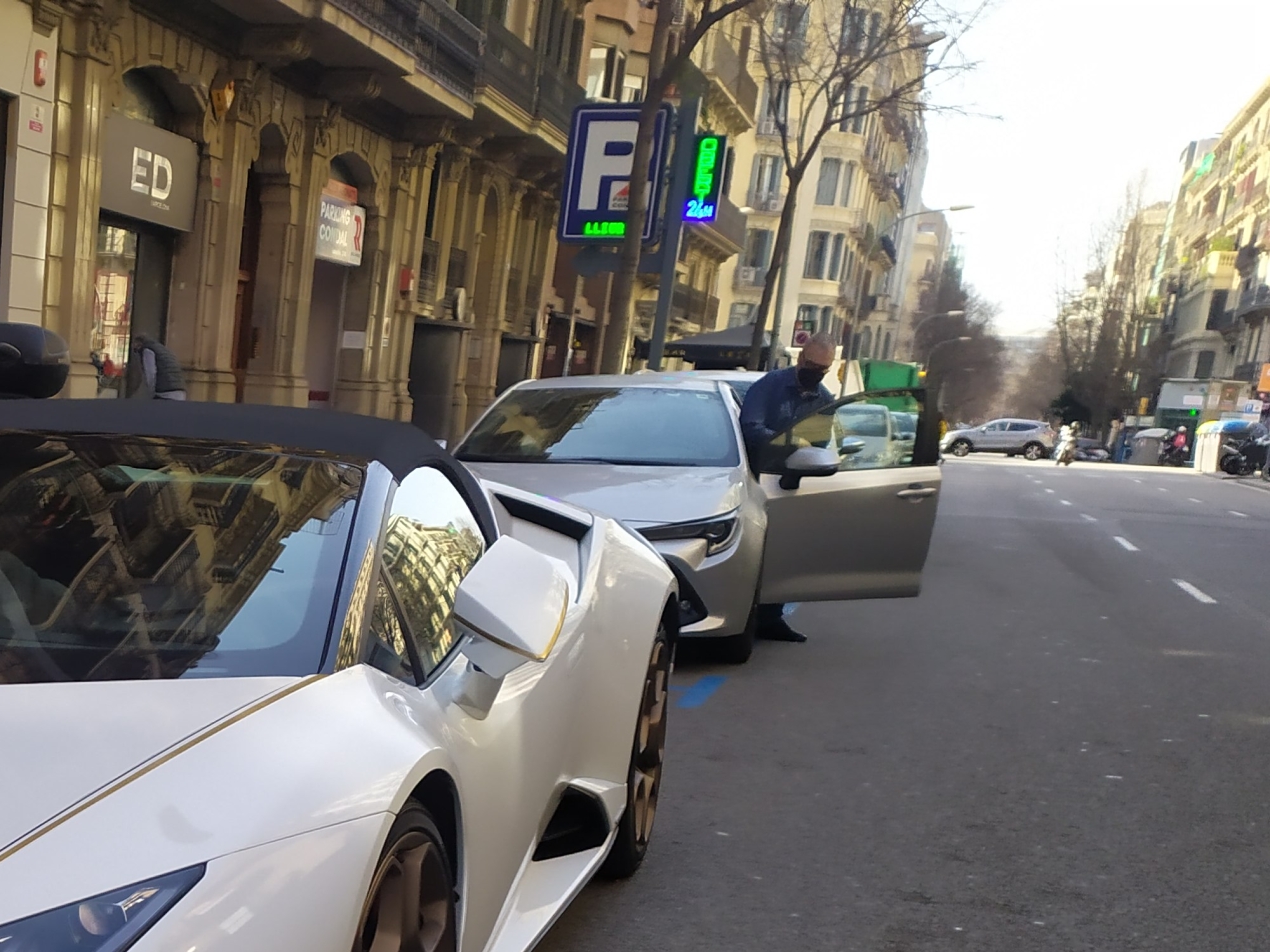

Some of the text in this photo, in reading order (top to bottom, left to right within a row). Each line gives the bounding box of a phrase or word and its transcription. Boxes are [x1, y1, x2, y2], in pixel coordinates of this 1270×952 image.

[131, 146, 173, 200] ED
[577, 120, 655, 210] P
[320, 201, 351, 226] PARKING
[584, 221, 626, 235] LLIUR
